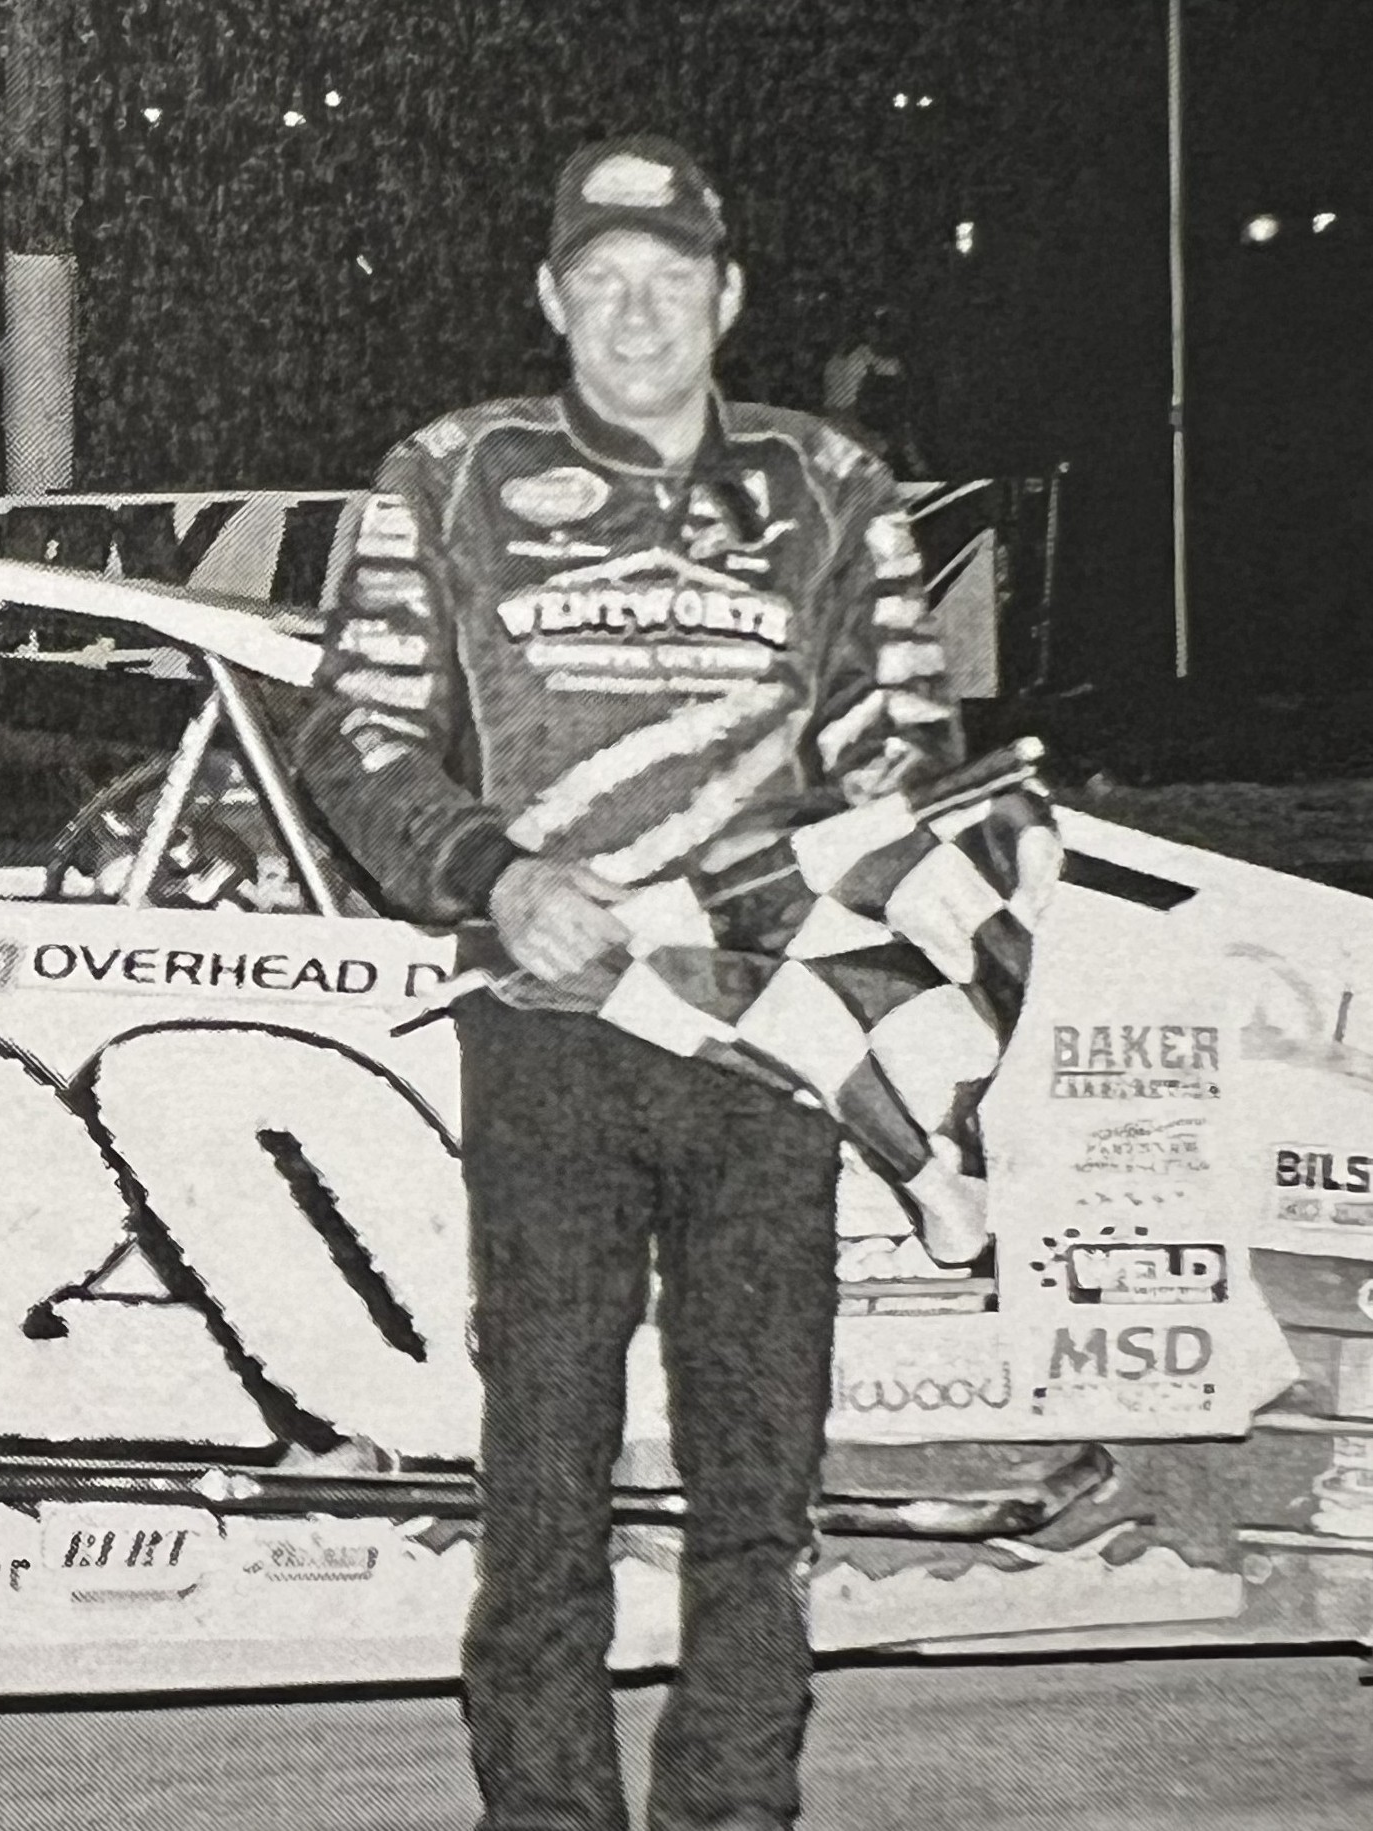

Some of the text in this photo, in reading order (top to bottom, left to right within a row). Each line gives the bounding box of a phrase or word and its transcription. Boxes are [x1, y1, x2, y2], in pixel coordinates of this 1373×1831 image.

[32, 943, 378, 994] OVERHEAD
[1053, 1025, 1219, 1070] BAKER
[1049, 1325, 1212, 1379] MSD
